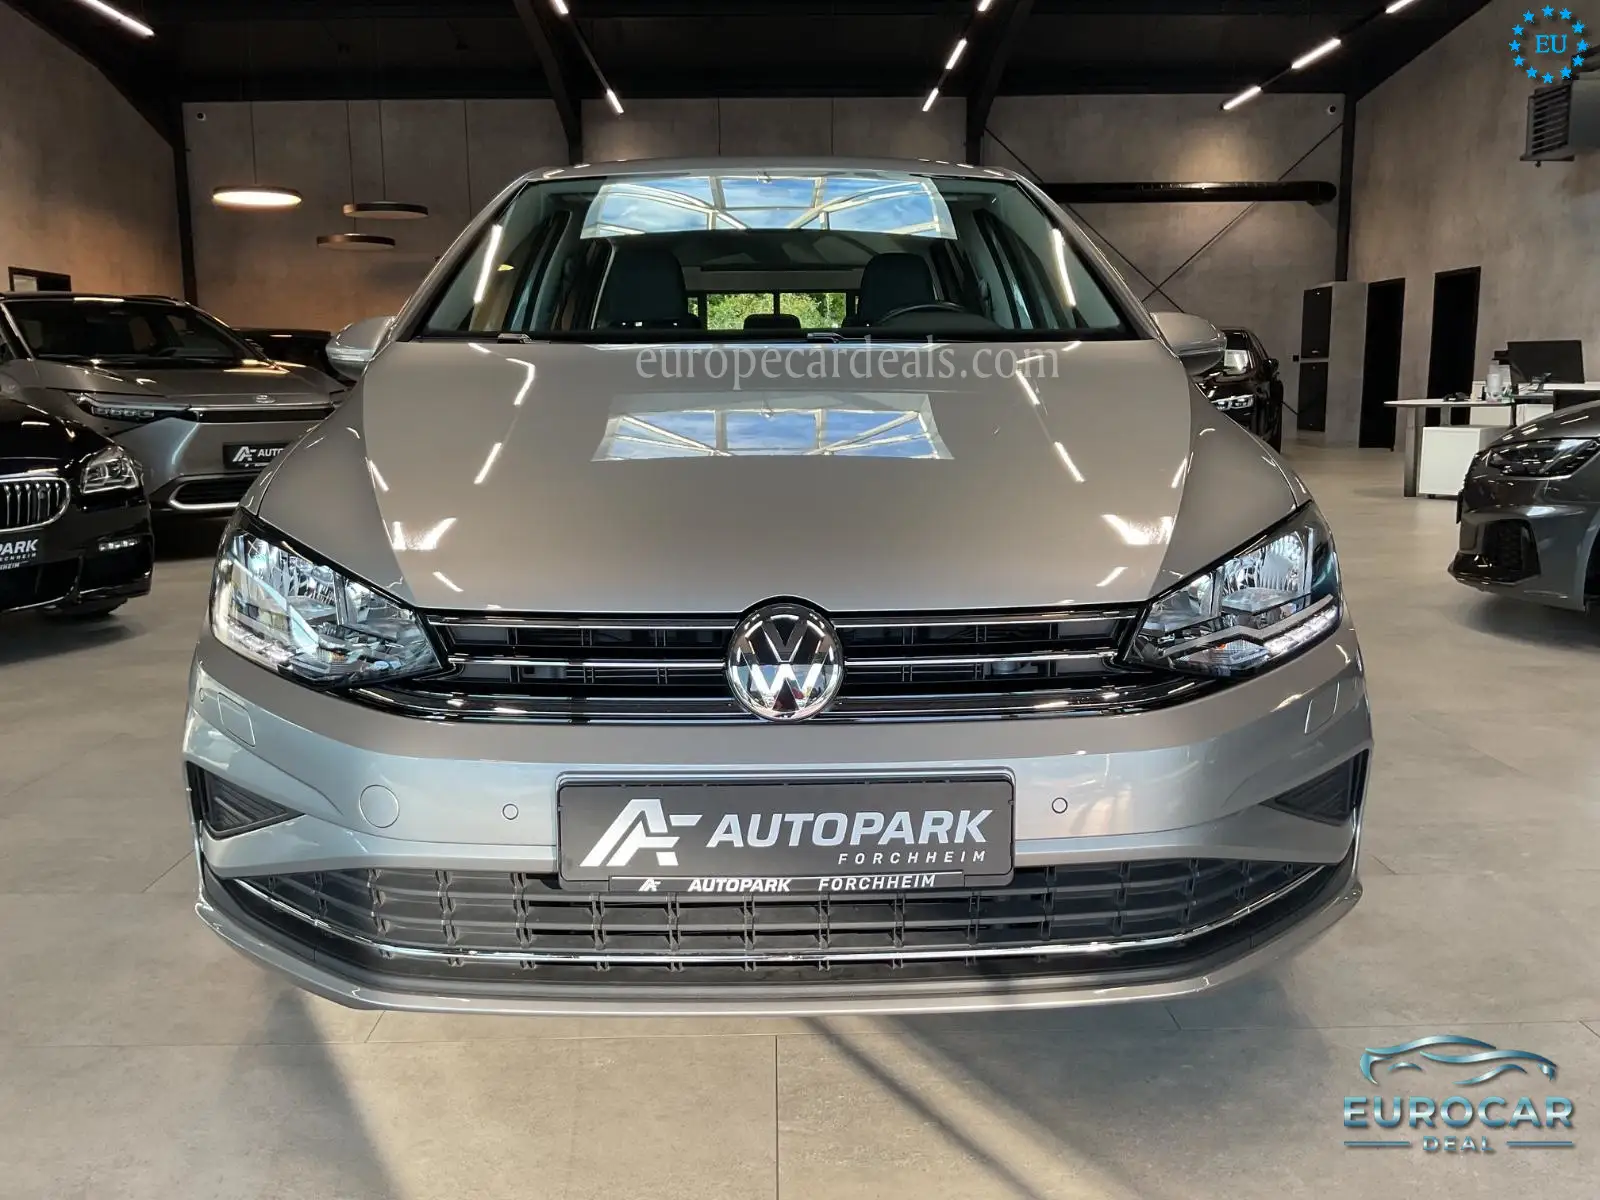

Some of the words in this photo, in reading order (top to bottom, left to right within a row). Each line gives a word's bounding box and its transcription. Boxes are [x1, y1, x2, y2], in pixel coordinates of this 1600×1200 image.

[705, 809, 993, 848] AUTOPARK
[838, 850, 986, 865] FORCHHEIM
[687, 878, 792, 893] AUTOPARK
[818, 874, 936, 891] FORCHHEIM
